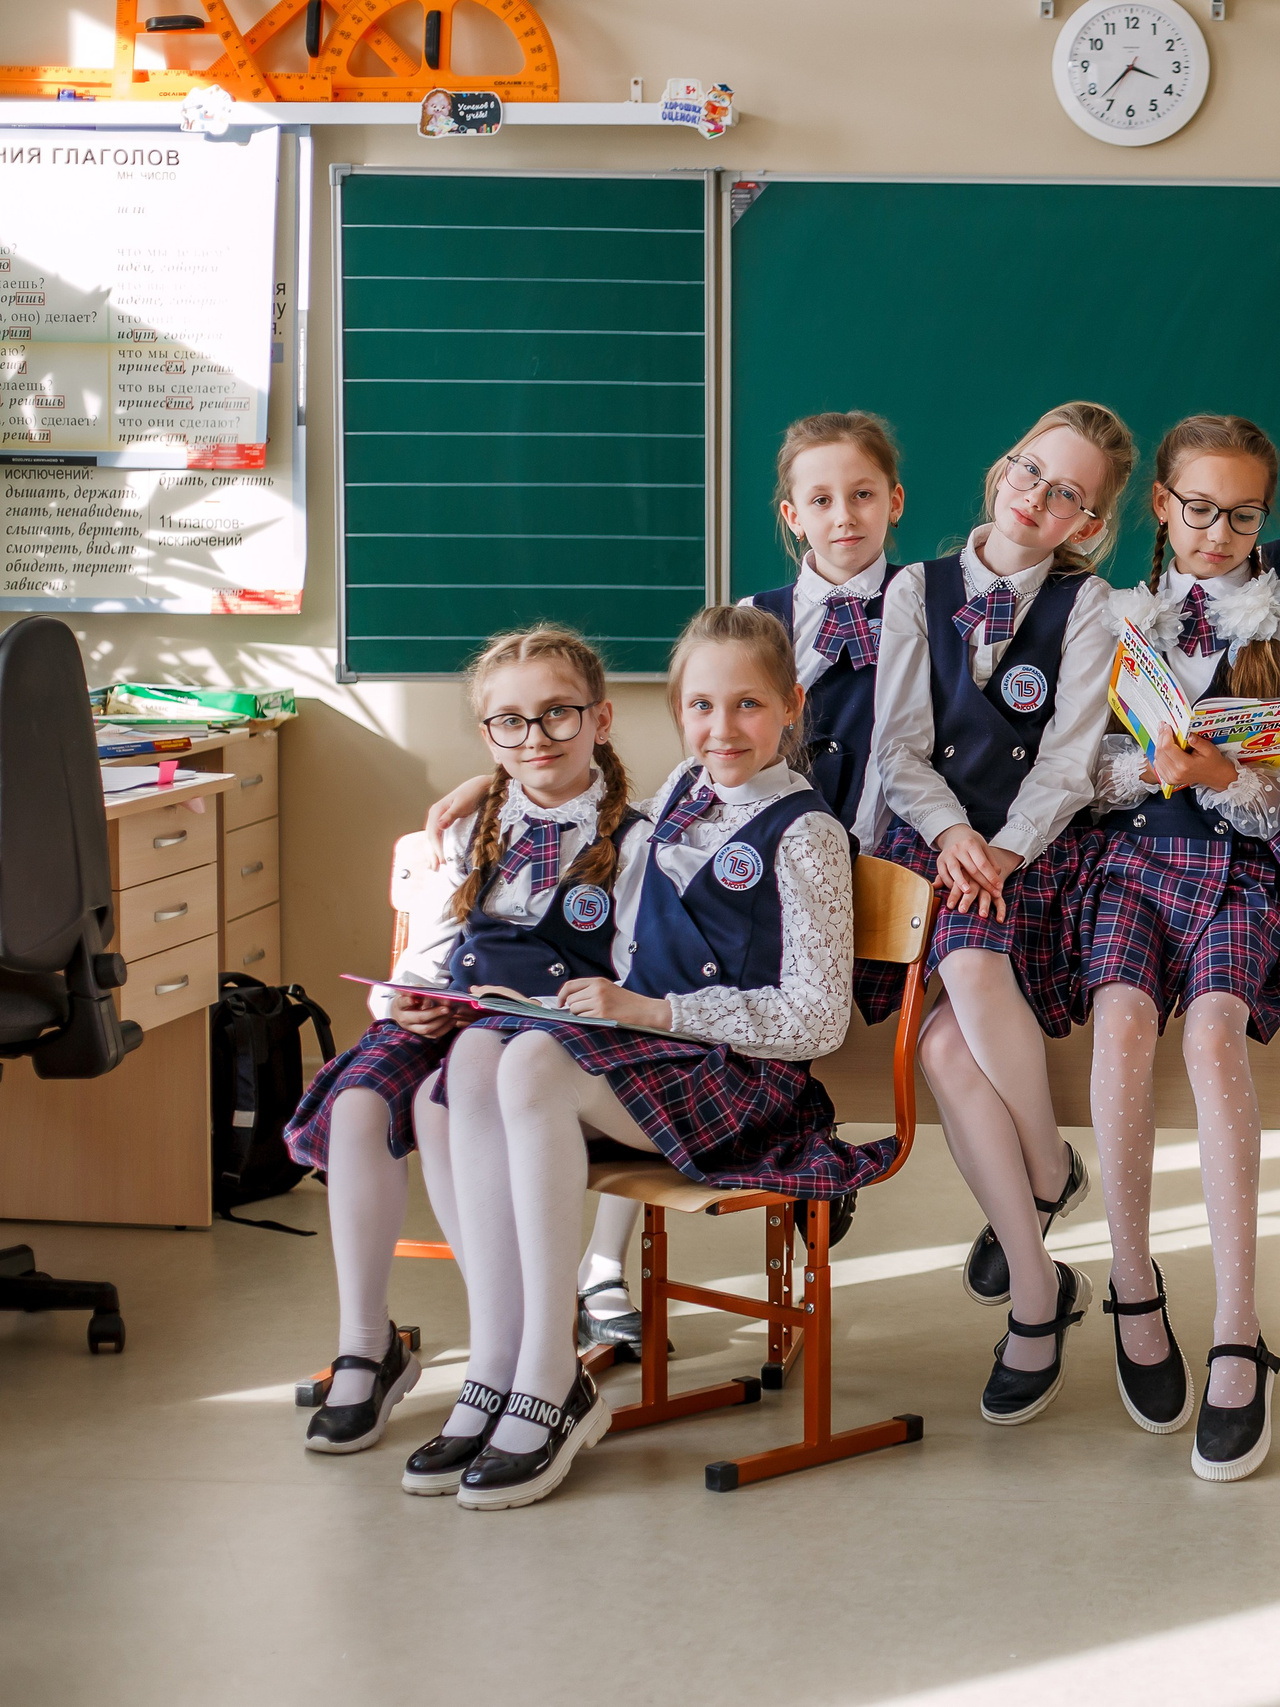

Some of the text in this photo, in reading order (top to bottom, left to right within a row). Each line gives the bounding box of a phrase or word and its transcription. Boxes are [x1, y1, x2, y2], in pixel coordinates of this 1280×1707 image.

[1104, 23, 1116, 35] 11
[1124, 16, 1140, 29] 12
[1151, 23, 1156, 35] 1
[1088, 38, 1103, 50] 10
[1166, 39, 1174, 51] 2
[1081, 60, 1089, 72] 9
[1172, 61, 1181, 73] 3
[686, 86, 696, 94] 5+
[1088, 82, 1097, 95] 8
[1164, 84, 1174, 96] 4
[664, 102, 702, 114] ХОРОШИХ
[1106, 99, 1114, 111] 7
[1126, 105, 1136, 117] 6
[1149, 100, 1158, 112] 5
[662, 112, 700, 124] ОЦЕНОК!
[52, 148, 180, 166] ГЛАГОЛОВ
[140, 172, 176, 180] ЧИСЛО
[11, 310, 97, 325] оно) делает?
[117, 315, 142, 324] что
[117, 328, 158, 342] идут,
[118, 350, 142, 358] что
[148, 350, 168, 358] мы
[118, 361, 186, 374] принесём,
[118, 382, 236, 394] что вы сделаете?
[118, 397, 249, 412] принесёте, решите
[41, 415, 98, 426] сделает?
[118, 416, 240, 429] что они сделают?
[118, 434, 190, 444] принесут,
[4, 466, 94, 480] исключений:
[158, 472, 207, 490] брить,
[6, 484, 141, 502] дышать, держать,
[6, 504, 142, 520] гнать, ненавидеть,
[159, 514, 244, 529] 11 глаголов-
[6, 522, 142, 540] слышать, вертеть,
[158, 534, 242, 546] исключений
[6, 541, 140, 558] смотреть, видеть,
[6, 559, 138, 578] обидеть, терпеть,
[1124, 656, 1136, 672] 4
[1015, 680, 1035, 697] 15
[1246, 734, 1276, 748] 4
[730, 856, 750, 876] 15
[578, 898, 598, 916] 15
[459, 1382, 500, 1414] RINO
[506, 1393, 561, 1428] URINO
